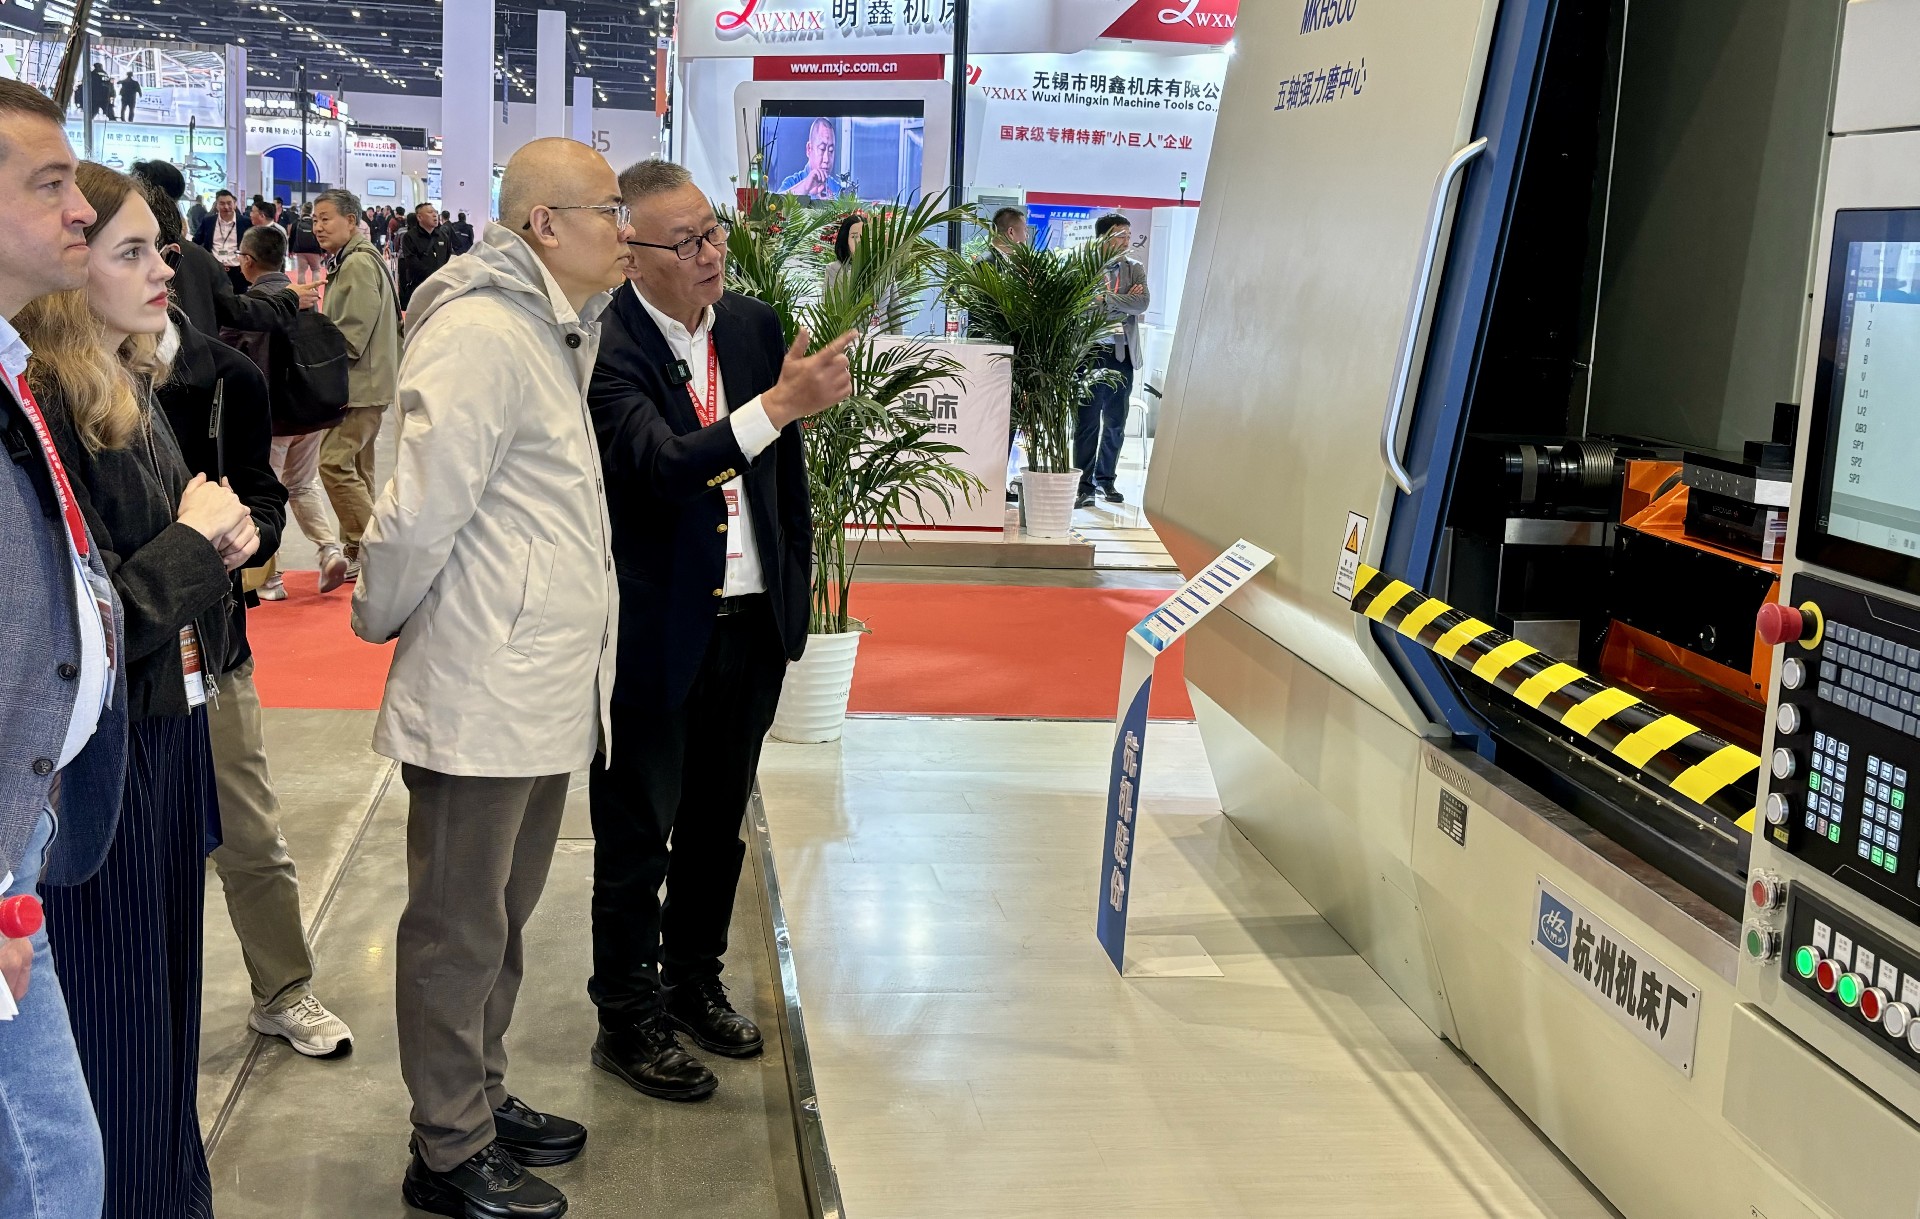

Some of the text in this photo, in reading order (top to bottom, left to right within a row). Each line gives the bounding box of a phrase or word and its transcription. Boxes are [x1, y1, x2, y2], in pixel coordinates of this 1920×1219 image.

[755, 11, 822, 31] WXMX
[1300, 0, 1357, 35] MKH500
[790, 61, 898, 76] www.mxjc.com.cn
[1033, 71, 1220, 100] 无锡市明鑫机床有限公
[1274, 57, 1367, 111] 五轴强力磨中心
[1032, 91, 1061, 103] Wuxi
[1064, 93, 1109, 107] Mingxin
[1113, 97, 1160, 109] Machine
[1164, 99, 1194, 110] Tools
[174, 134, 224, 147] BMC
[1852, 439, 1864, 451] SP1
[1850, 456, 1862, 468] SP2
[1572, 917, 1688, 1041] 杭州机床厂
